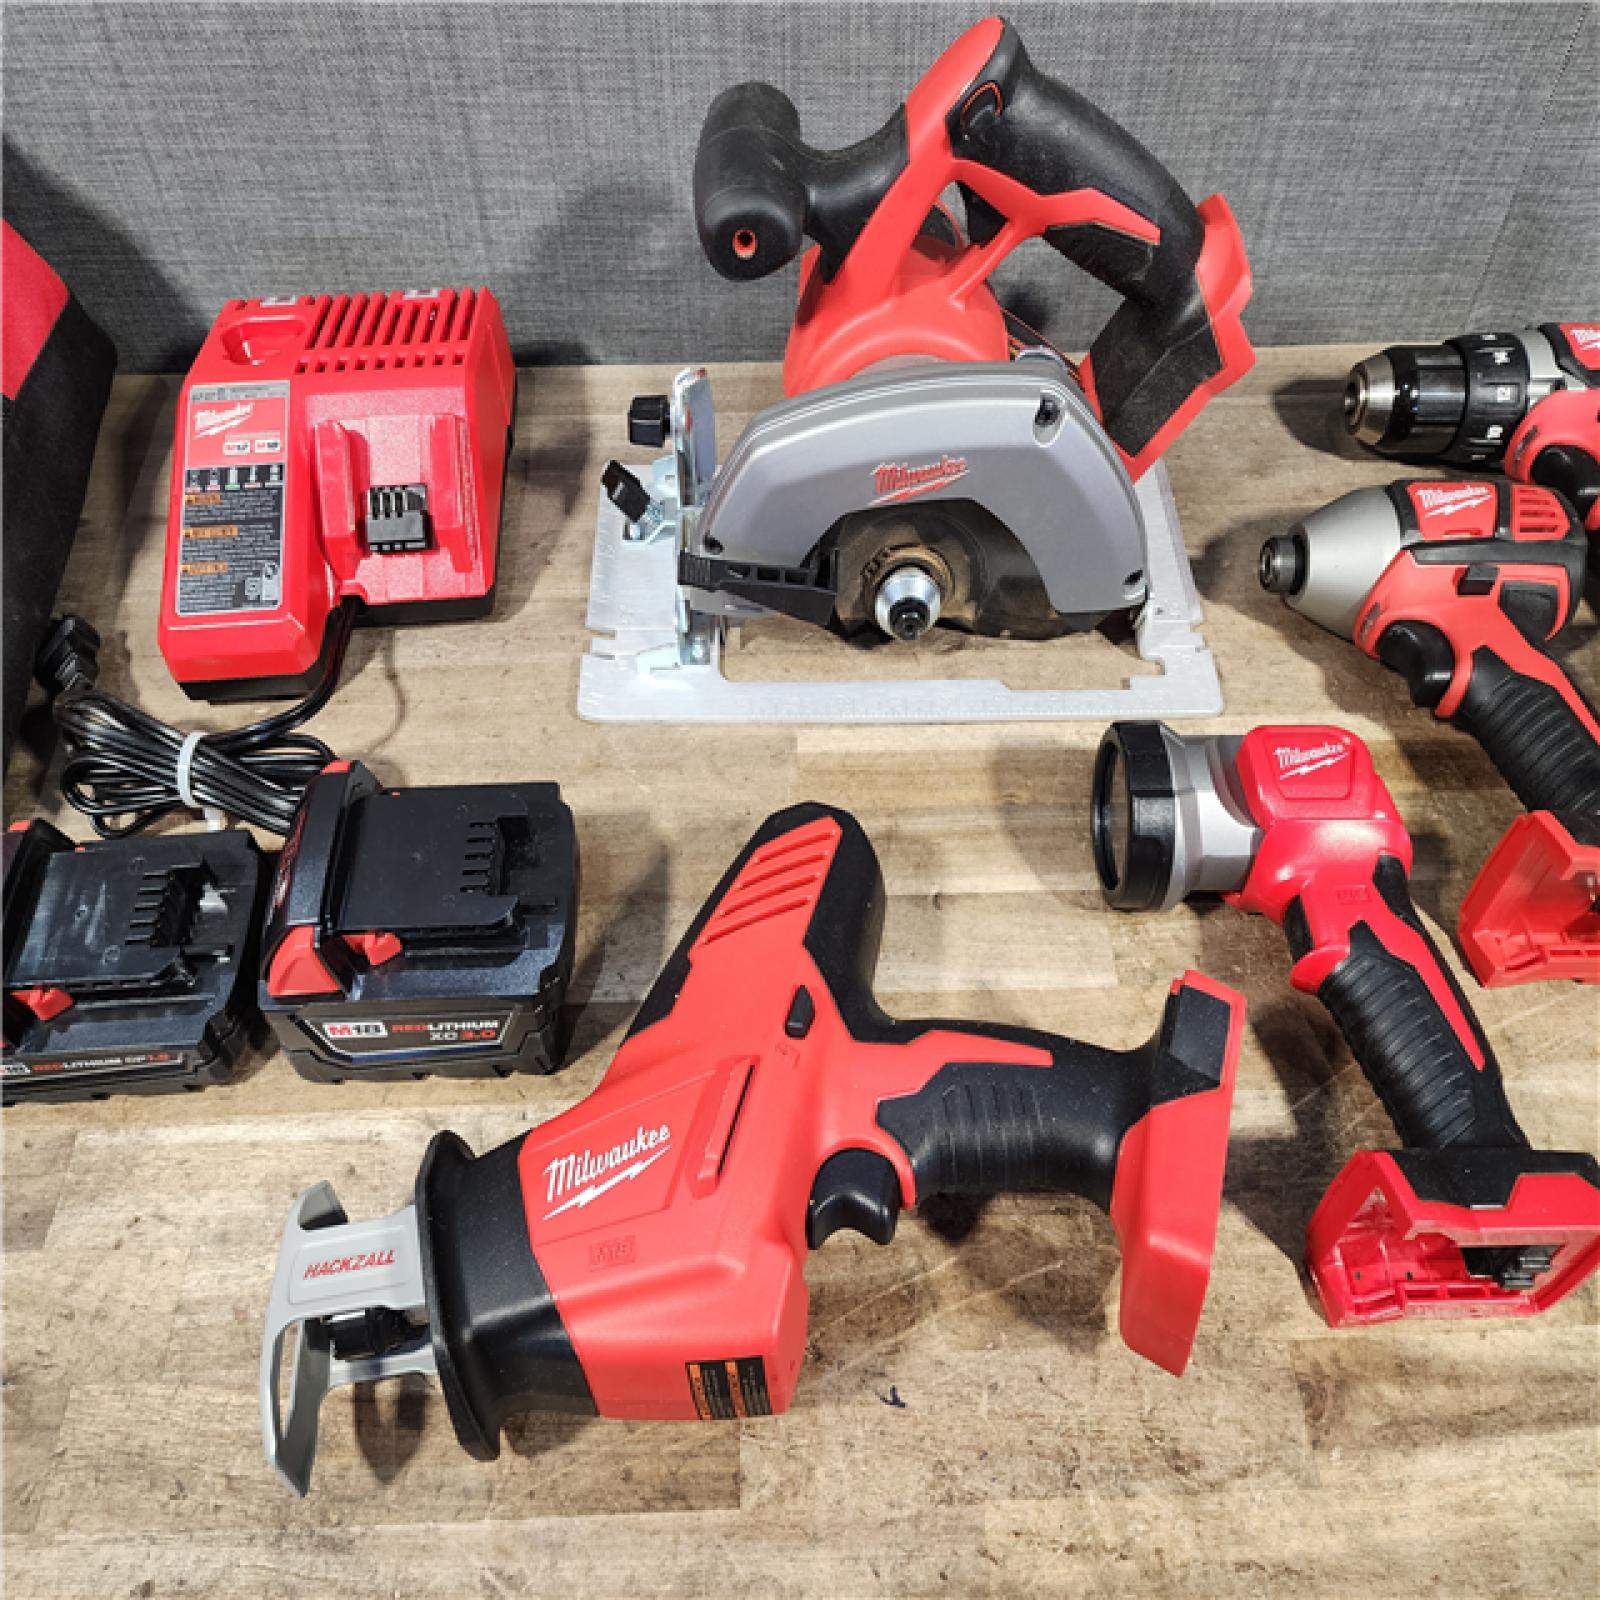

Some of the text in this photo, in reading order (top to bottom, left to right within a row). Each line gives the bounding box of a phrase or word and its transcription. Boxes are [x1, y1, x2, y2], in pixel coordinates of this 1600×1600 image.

[869, 454, 967, 496] Milwaukee
[1415, 485, 1488, 510] Milwaukee
[1272, 742, 1344, 770] Milwaukee
[329, 1020, 499, 1036] M18 REDLITHIUM
[543, 1124, 671, 1203] Milwaukee
[303, 1248, 396, 1281] HACKZALL
